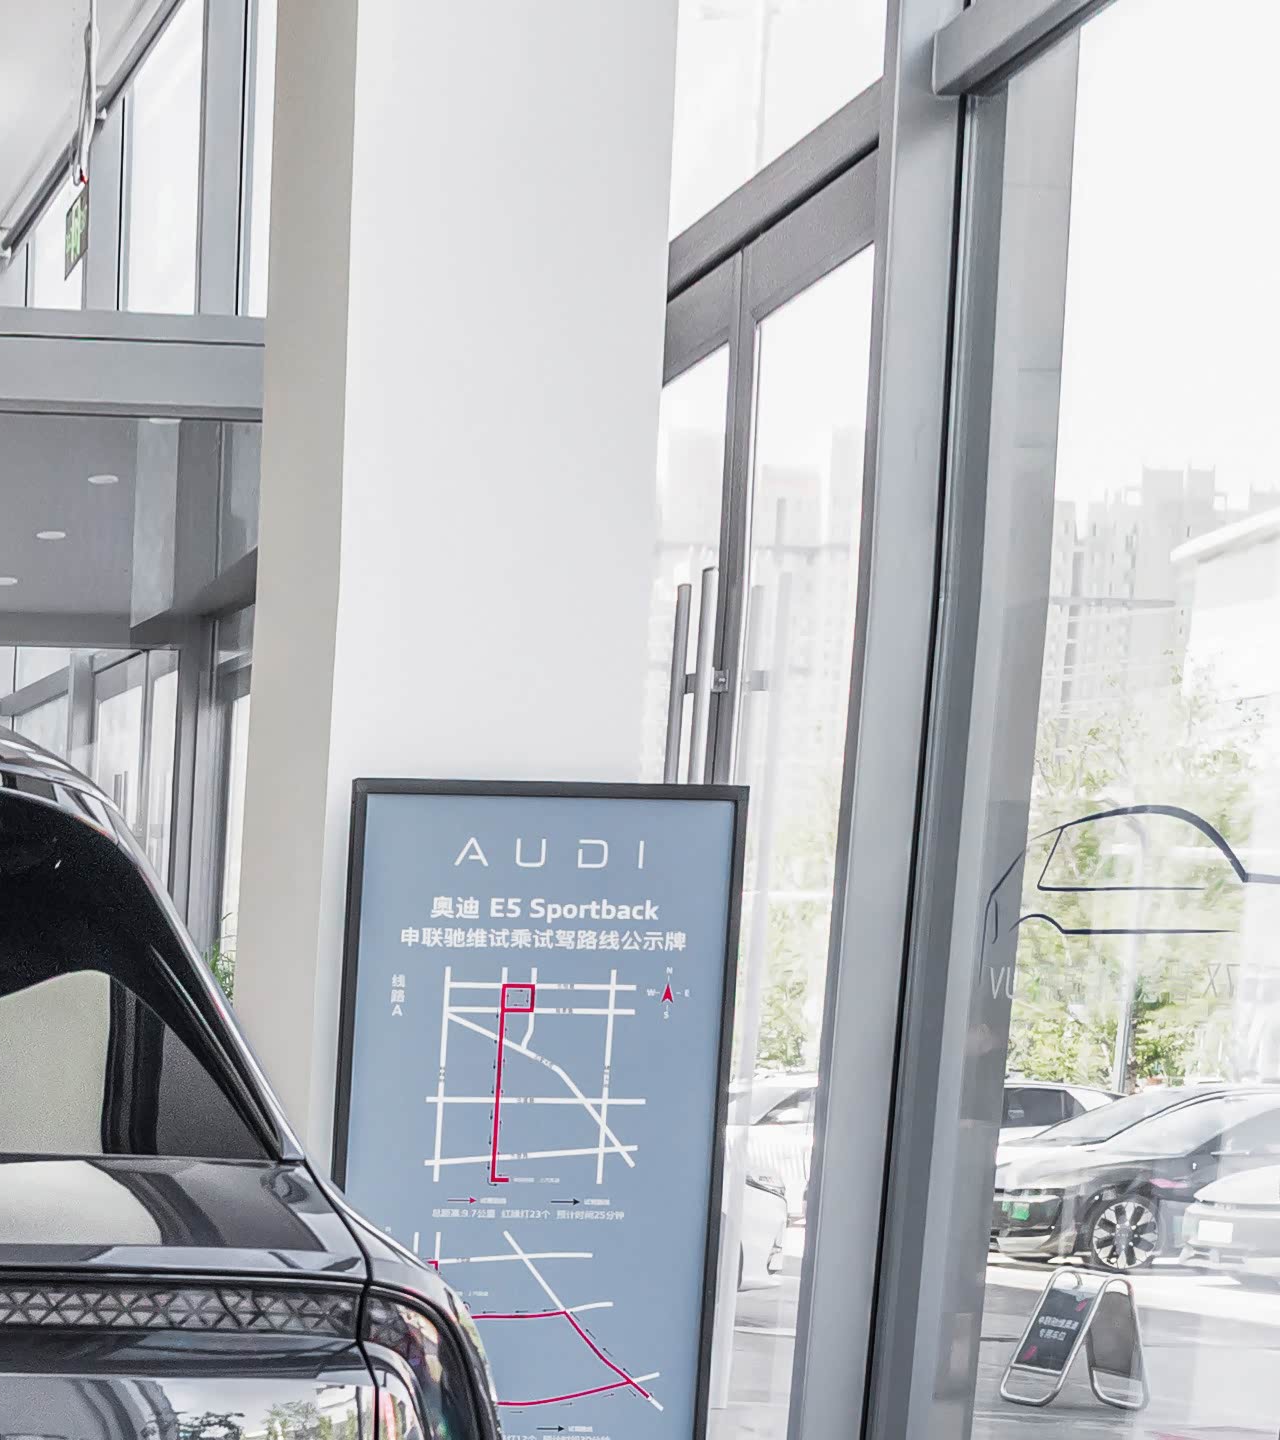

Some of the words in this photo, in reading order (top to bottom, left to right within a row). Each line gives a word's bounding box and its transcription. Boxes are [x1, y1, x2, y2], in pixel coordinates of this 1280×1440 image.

[454, 837, 645, 869] AUDI
[430, 896, 480, 919] 奥迪
[490, 898, 521, 918] E5
[529, 899, 659, 923] Sportback
[400, 926, 687, 951] 申联驰维试乘试驾路线公示牌
